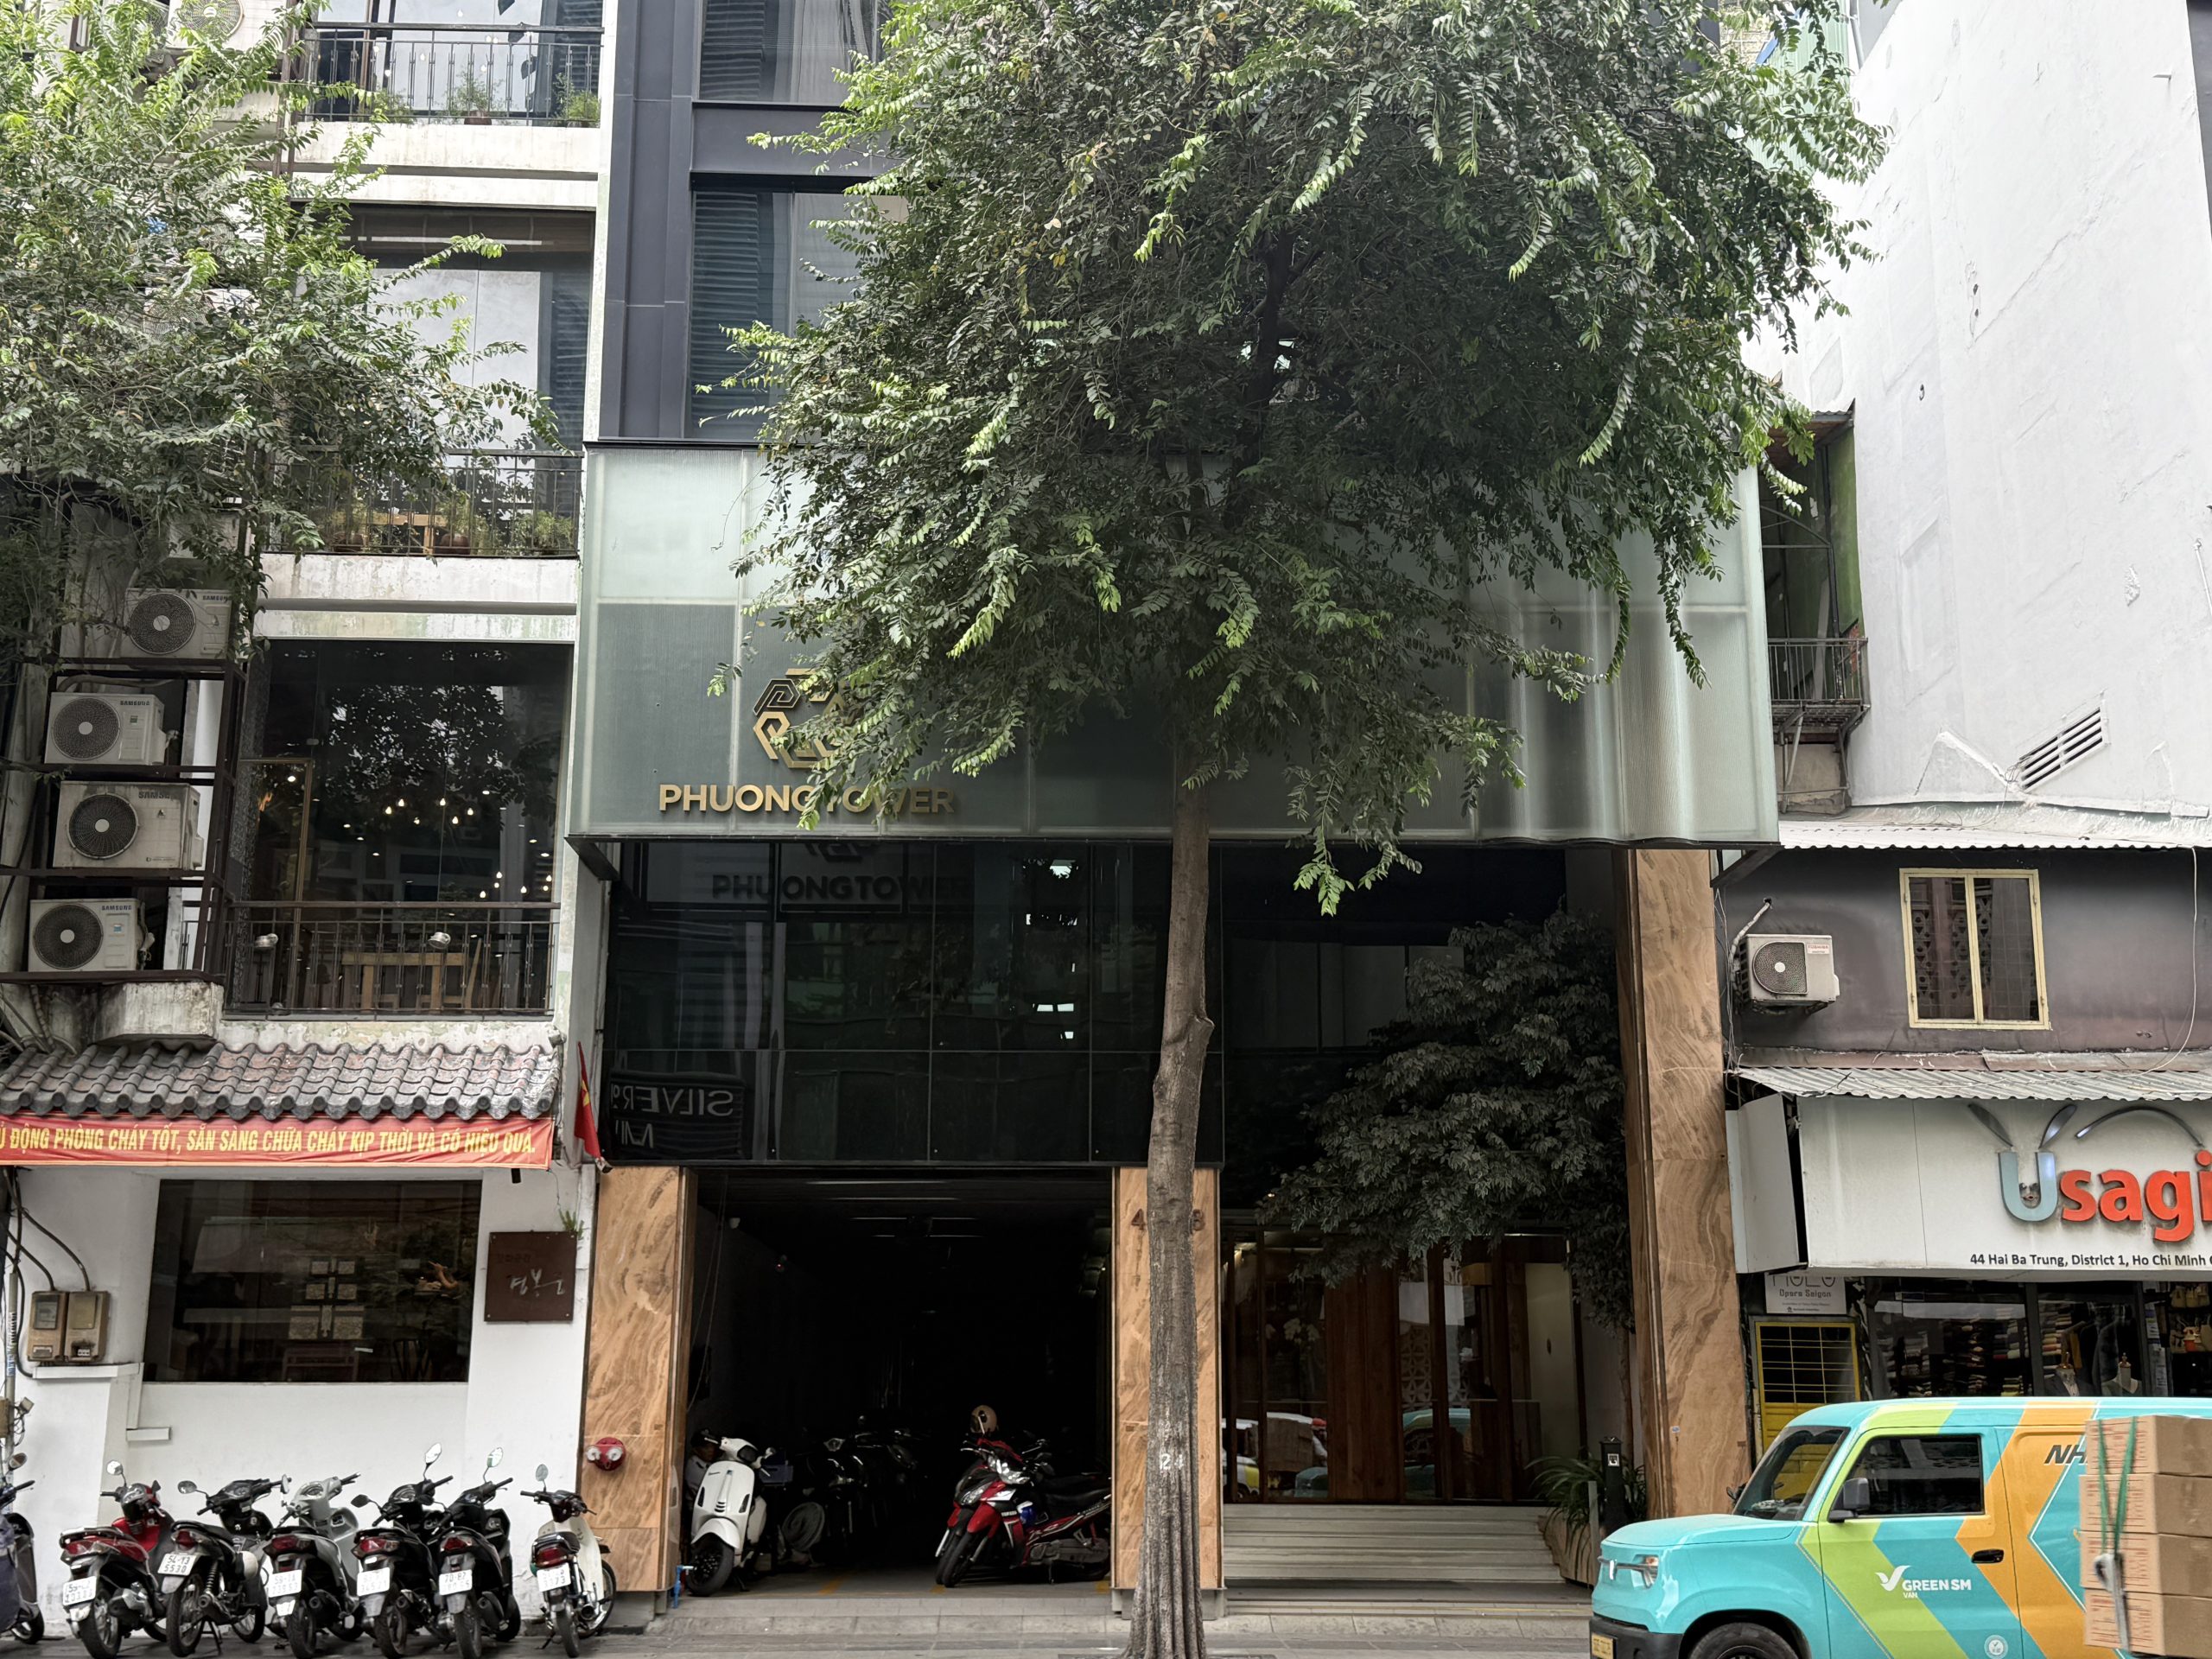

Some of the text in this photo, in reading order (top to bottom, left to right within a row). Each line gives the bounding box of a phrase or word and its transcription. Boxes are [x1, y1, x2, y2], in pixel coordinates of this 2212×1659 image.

[10, 1122, 50, 1154] ĐỘNG
[54, 1123, 105, 1150] PHÒNG
[108, 1123, 149, 1151] CHÁY
[152, 1122, 182, 1154] TỐT,
[186, 1122, 217, 1152] SẴN
[219, 1125, 259, 1152] SÀNG
[262, 1126, 302, 1152] CHỮA
[307, 1126, 347, 1152] CHÁY
[350, 1130, 375, 1158] KỊP
[379, 1126, 414, 1153] THỜI
[417, 1127, 435, 1153] VÀ
[440, 1127, 461, 1153] CÓ
[464, 1127, 499, 1158] HIỆU
[503, 1127, 537, 1154] QUẢ.
[1997, 1149, 2212, 1243] Usagi
[1970, 1254, 1986, 1264] 44
[1988, 1254, 2008, 1265] Hai
[2012, 1254, 2027, 1265] Ba
[2030, 1254, 2069, 1268] Trung,
[2071, 1254, 2115, 1266] District
[2118, 1255, 2129, 1268] 1,
[2133, 1255, 2149, 1266] Ho
[2152, 1255, 2171, 1266] Chi
[2175, 1255, 2207, 1267] Minh
[1779, 1288, 1832, 1299] Opera Saigon
[1902, 1579, 1973, 1592] GREEN SM
